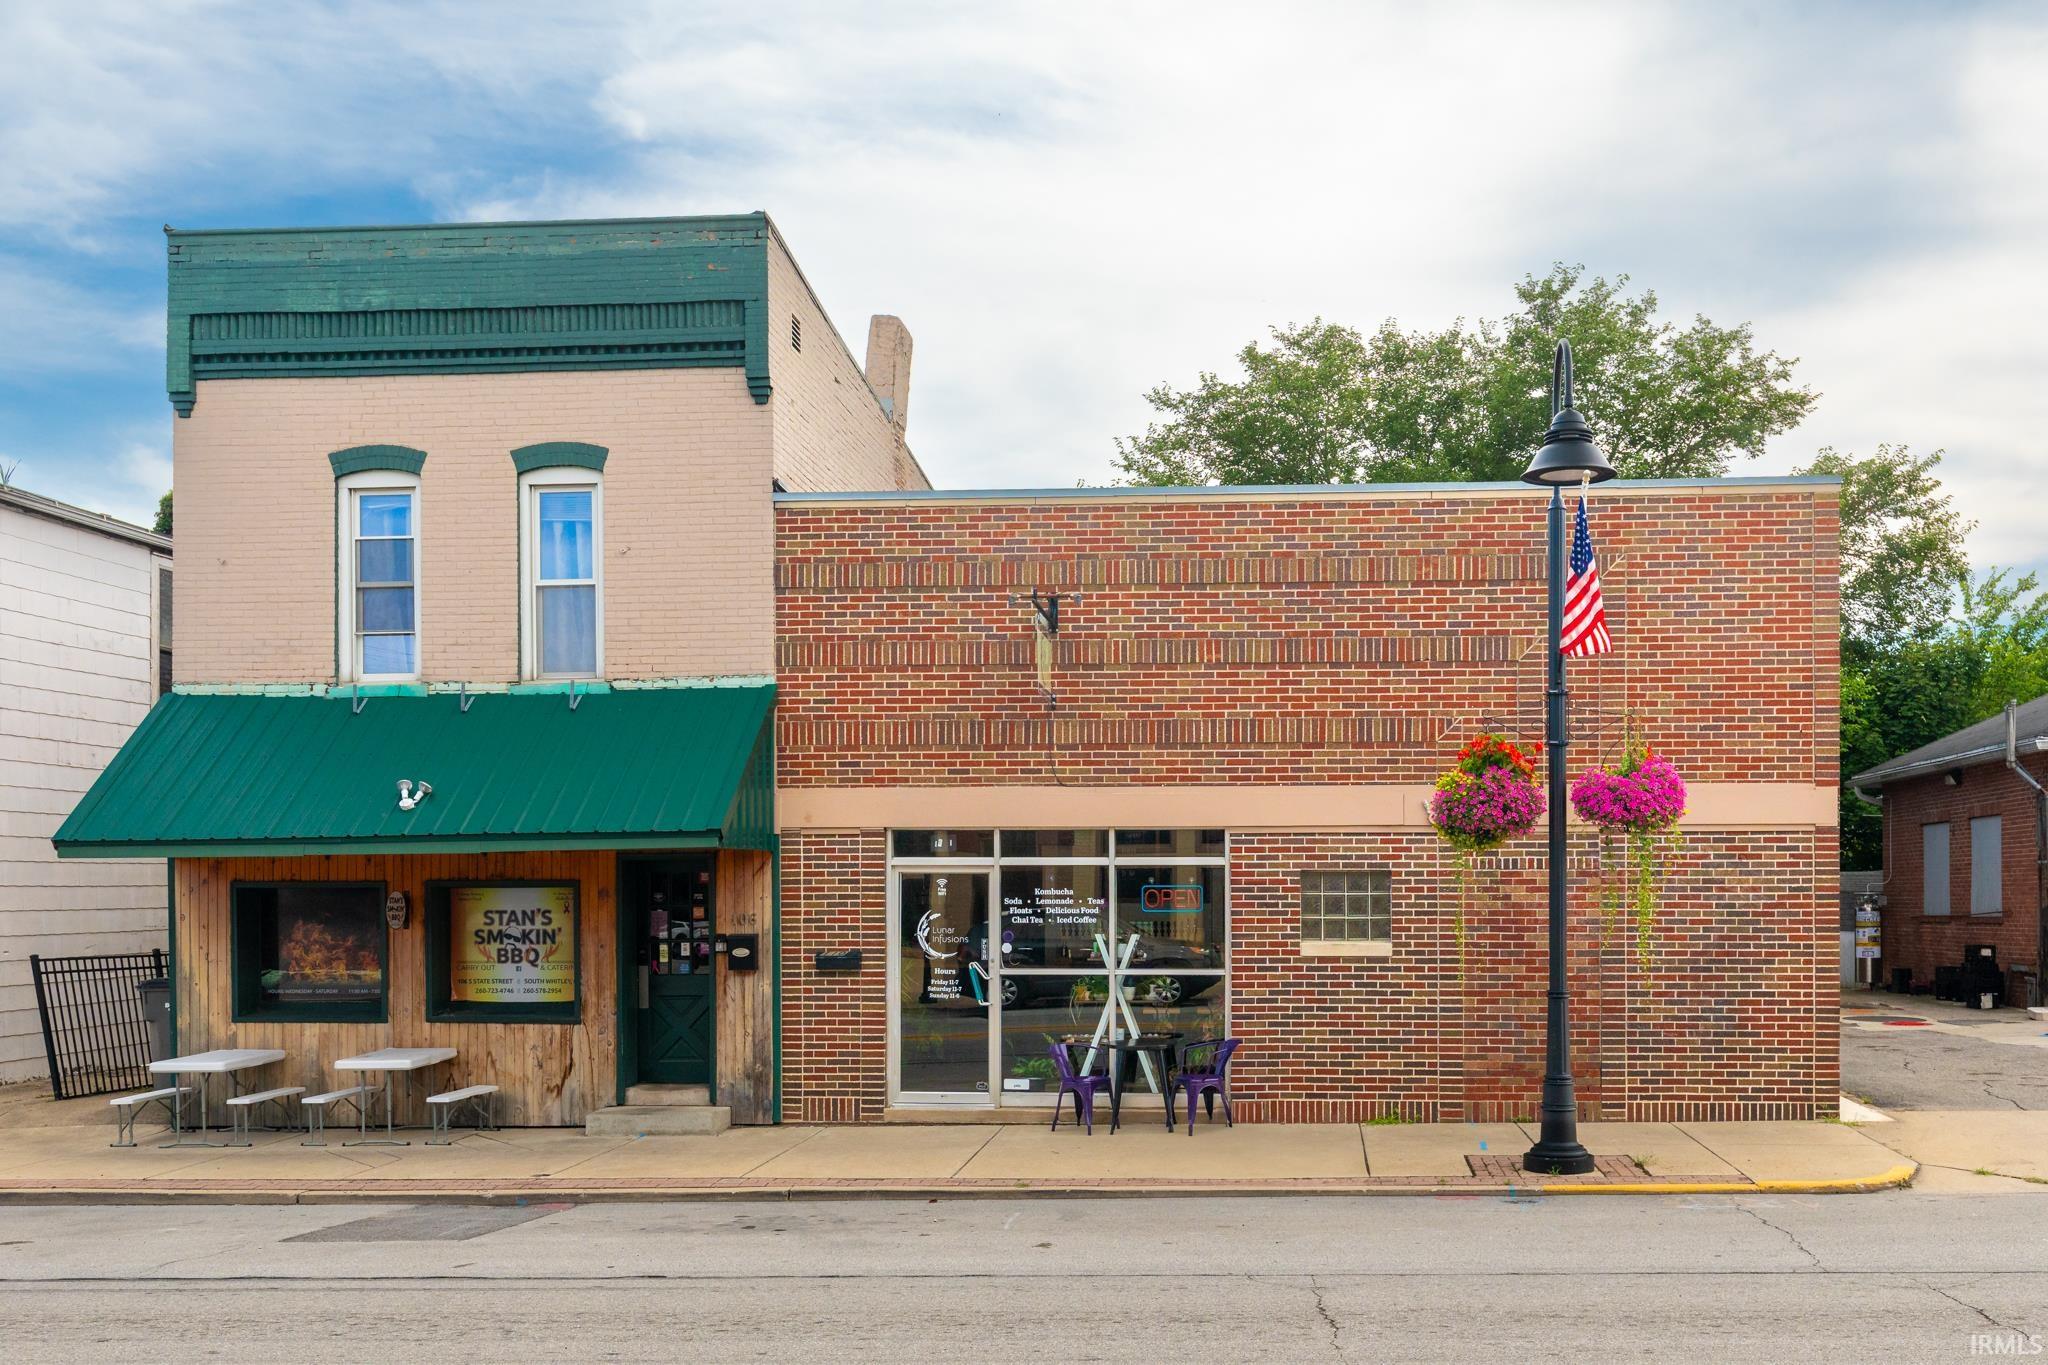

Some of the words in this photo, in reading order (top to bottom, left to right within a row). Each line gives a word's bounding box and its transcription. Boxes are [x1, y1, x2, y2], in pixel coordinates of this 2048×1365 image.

[1145, 889, 1200, 908] OPEN
[483, 908, 553, 926] STAN'S
[932, 926, 955, 934] Lunar
[932, 934, 969, 944] Infusions
[496, 947, 540, 968] BBQ
